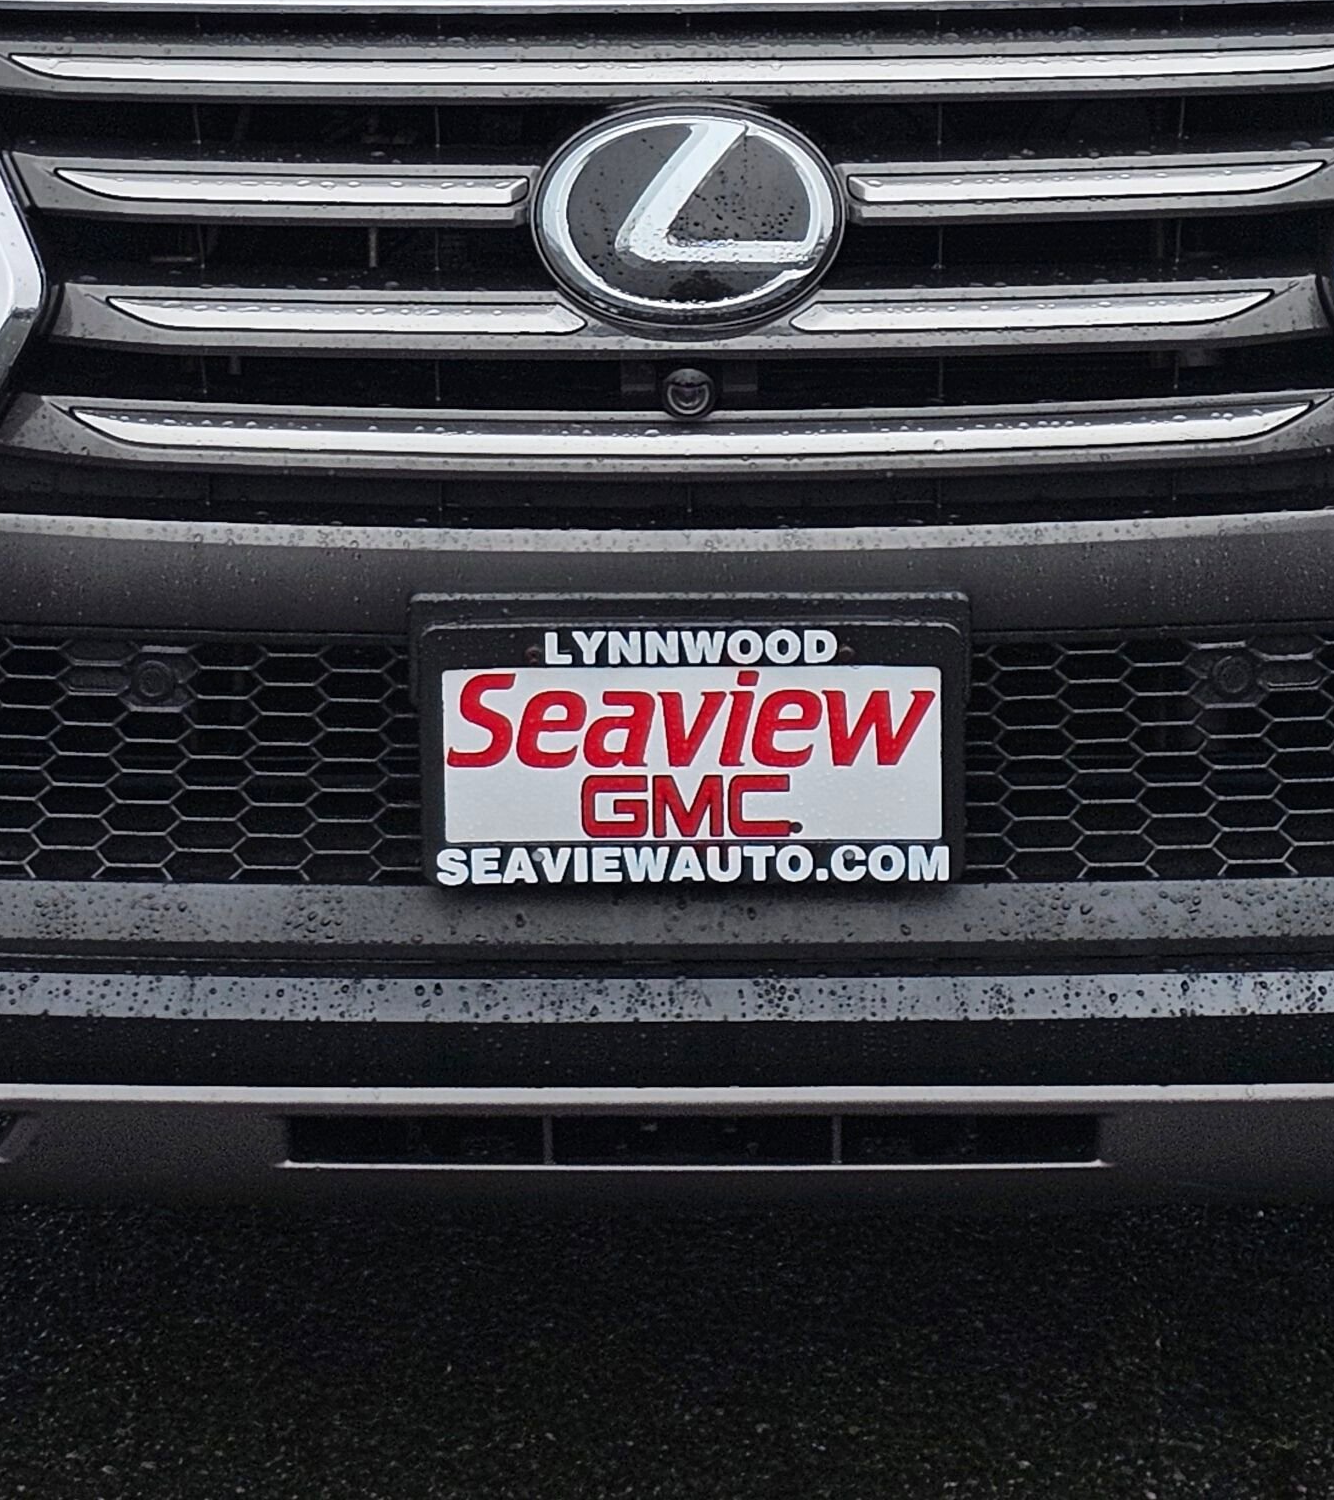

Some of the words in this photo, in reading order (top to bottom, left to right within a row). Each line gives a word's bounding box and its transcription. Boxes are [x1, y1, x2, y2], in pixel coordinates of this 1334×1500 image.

[544, 629, 838, 665] LYNNWOOD
[447, 670, 936, 768] Seaview
[580, 773, 793, 839] GMC
[436, 845, 950, 887] SEAVIEWAUTO.COM
